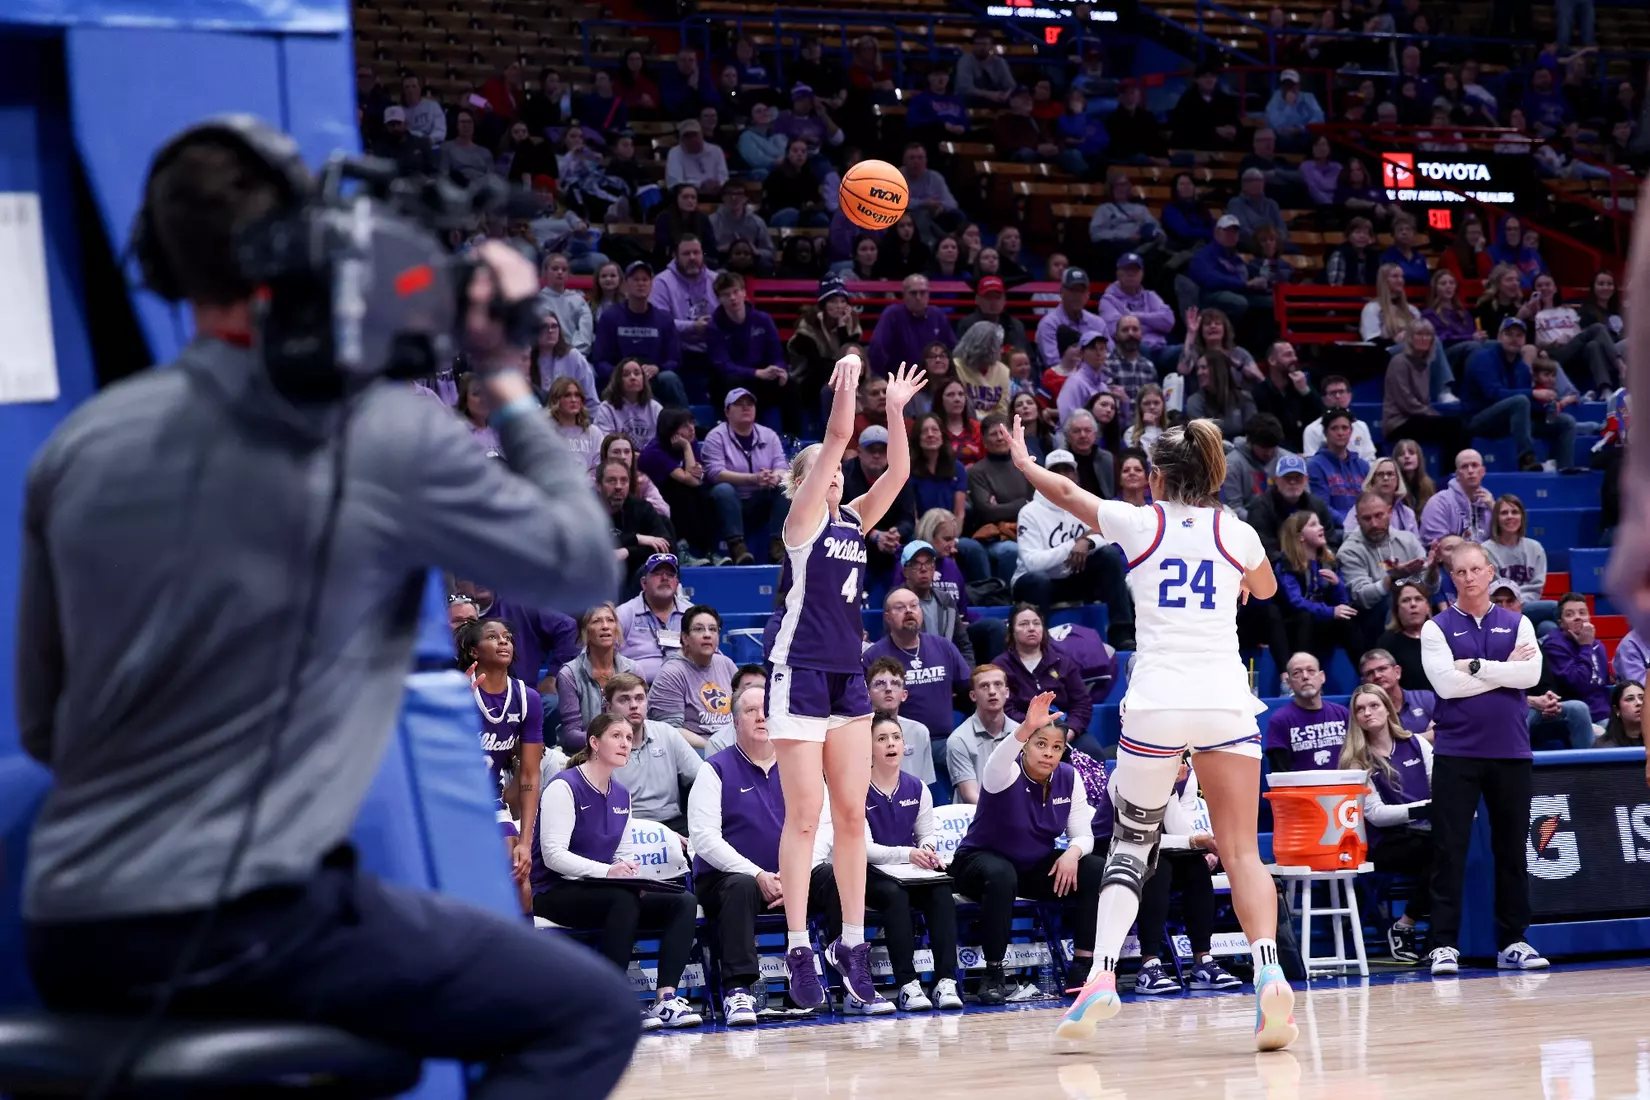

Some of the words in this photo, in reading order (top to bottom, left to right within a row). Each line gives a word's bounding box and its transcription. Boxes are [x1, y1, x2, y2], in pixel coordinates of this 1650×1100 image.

[1417, 162, 1491, 181] TOYOTA
[869, 187, 902, 204] NCAA
[857, 203, 898, 224] Wilson
[841, 567, 859, 603] 4
[1158, 558, 1216, 609] 24
[1290, 721, 1347, 744] K-STATE
[1338, 799, 1359, 829] G
[632, 828, 667, 845] itol
[1526, 794, 1581, 880] G
